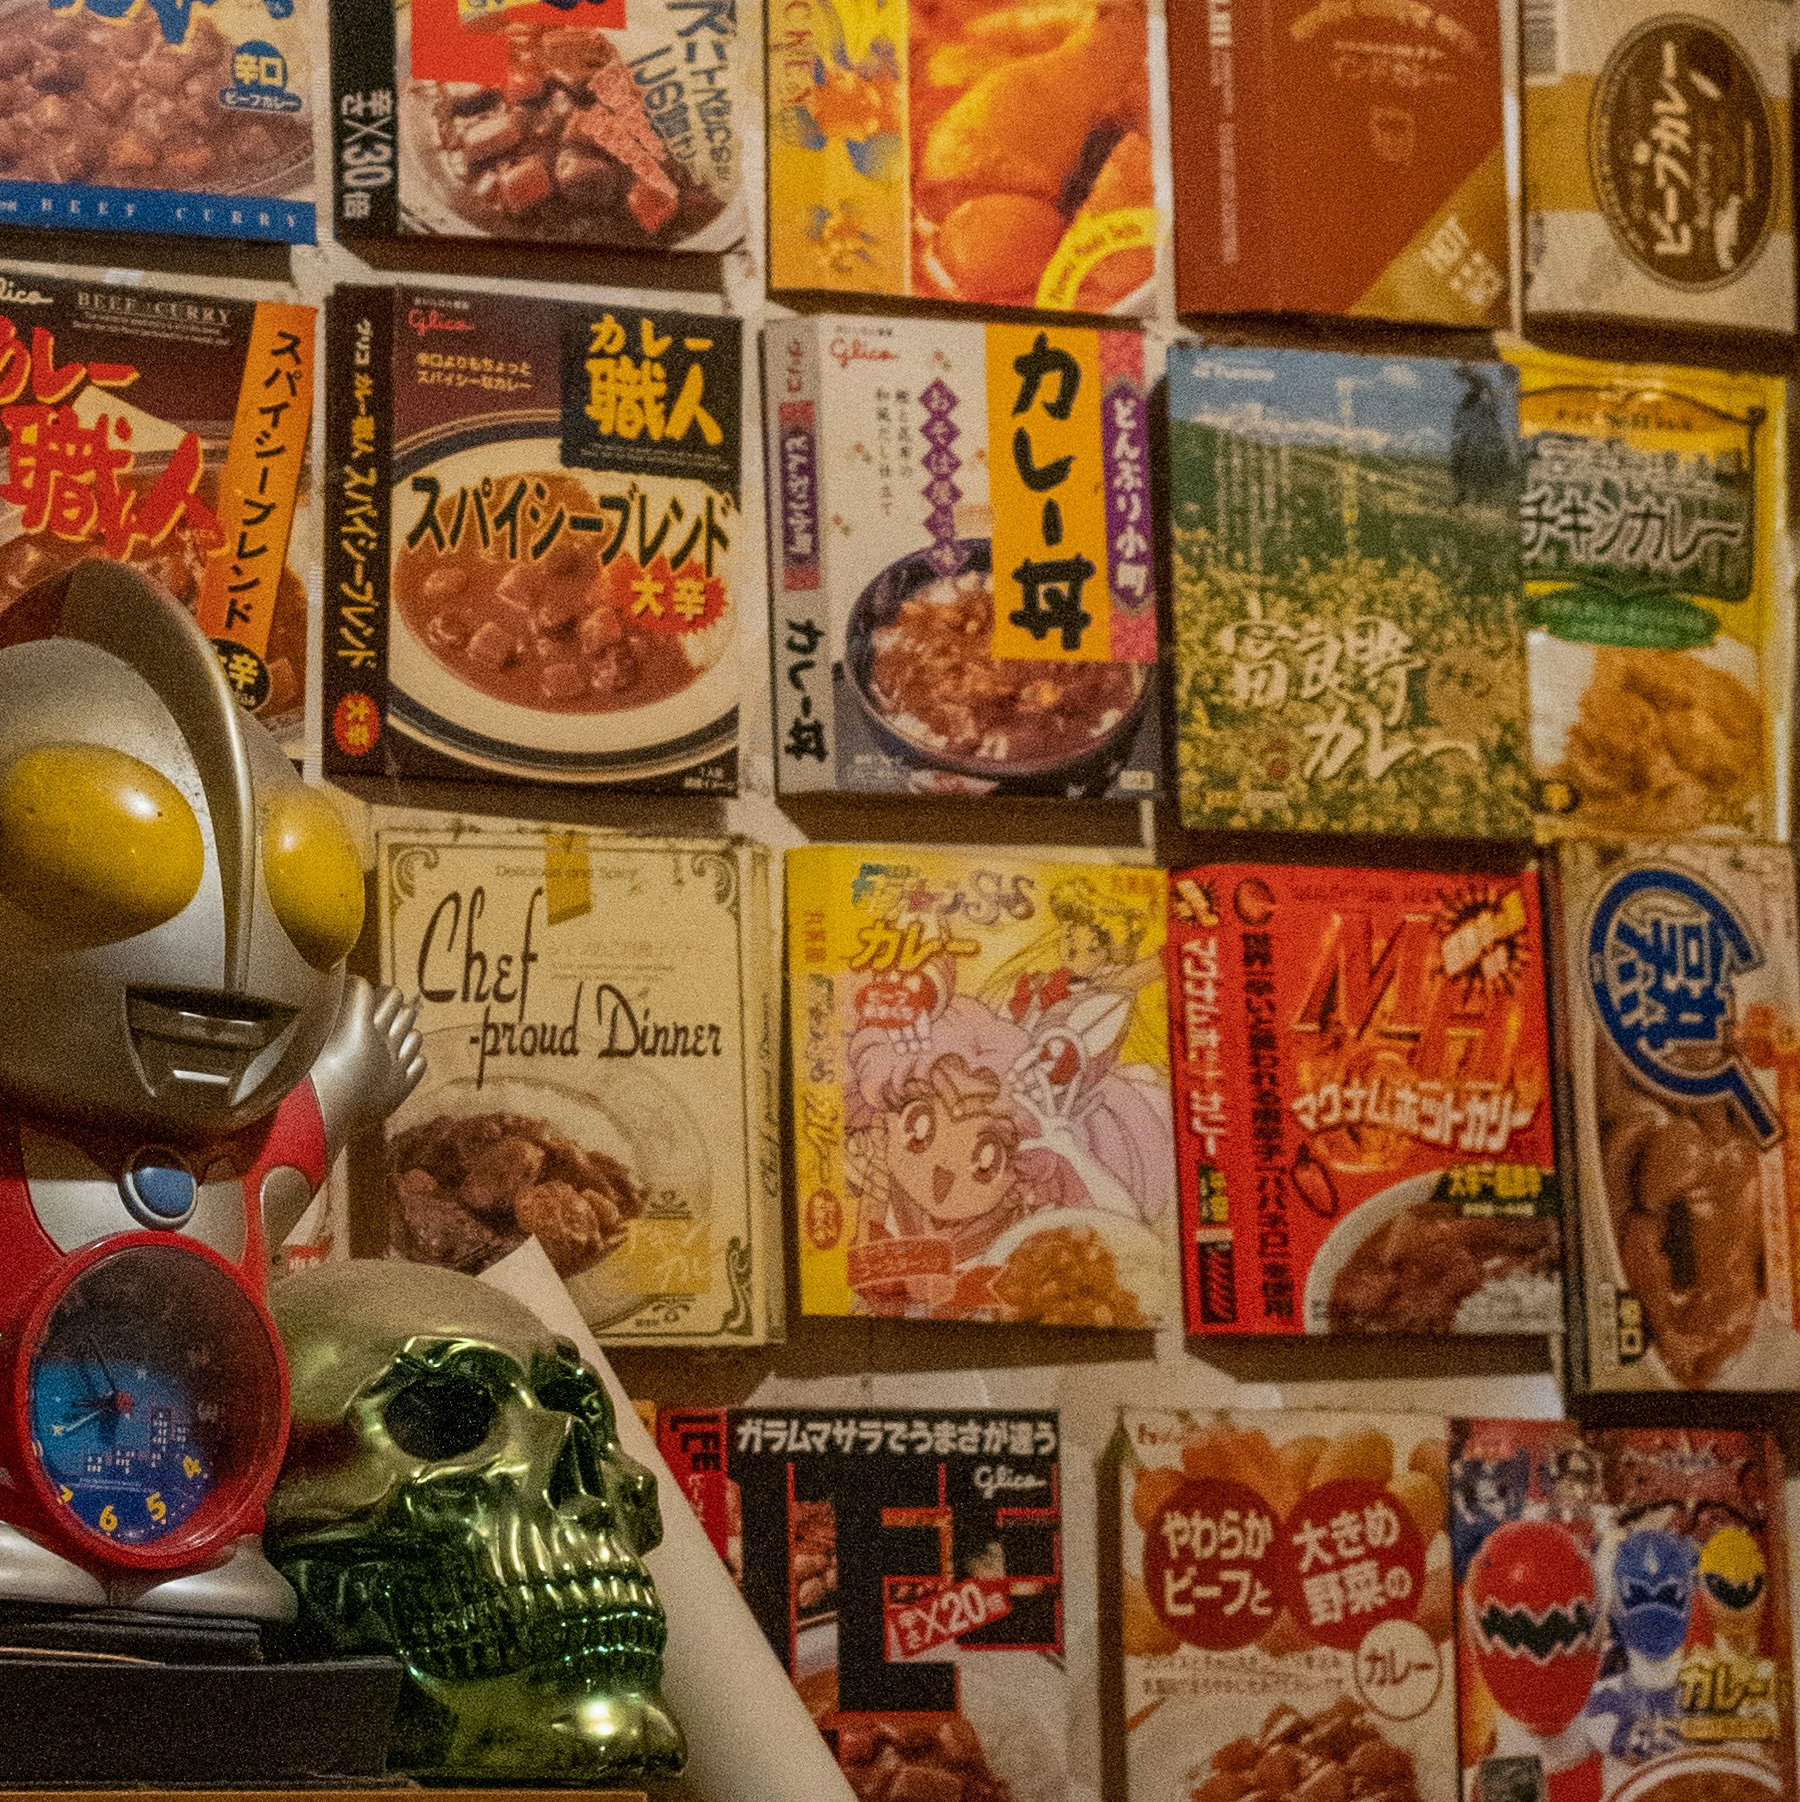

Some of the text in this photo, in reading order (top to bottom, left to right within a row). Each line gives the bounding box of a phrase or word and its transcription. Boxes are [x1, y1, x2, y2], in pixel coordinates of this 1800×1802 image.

[234, 54, 284, 84] 辛口
[1655, 41, 1693, 255] ビーフカレー
[77, 292, 232, 325] BEEF CURRY
[408, 309, 475, 335] Glico
[587, 314, 713, 355] カレー
[830, 338, 898, 368] Glico
[416, 371, 532, 392] スパイシーなカレー
[584, 357, 723, 446] 職人
[0, 404, 231, 560] 職人
[224, 331, 302, 631] スパイシーブレンド
[1009, 333, 1097, 651] カレー丼
[1112, 400, 1149, 596] どんぶり小町
[407, 475, 731, 577] スパイシーブレンド
[1520, 484, 1743, 567] チキンカレー
[337, 466, 378, 669] スパイシーブレンド
[631, 575, 707, 620] 大辛
[783, 620, 827, 764] カレー丼
[1302, 706, 1480, 781] カレー
[418, 886, 544, 1021] Chef
[850, 918, 980, 971] カレー
[597, 983, 722, 1060] Dinner
[670, 1416, 720, 1472] LEE
[737, 1419, 1057, 1456] ガラムマサラでうまさが違う
[145, 1492, 167, 1520] 5
[974, 1466, 1046, 1498] Glico
[98, 1505, 119, 1532] 6
[1163, 1510, 1272, 1561] やわらか
[1293, 1501, 1399, 1572] 大きめ
[1164, 1567, 1272, 1617] ビーフと
[1303, 1563, 1412, 1626] 野菜の
[1363, 1649, 1433, 1688] カレー
